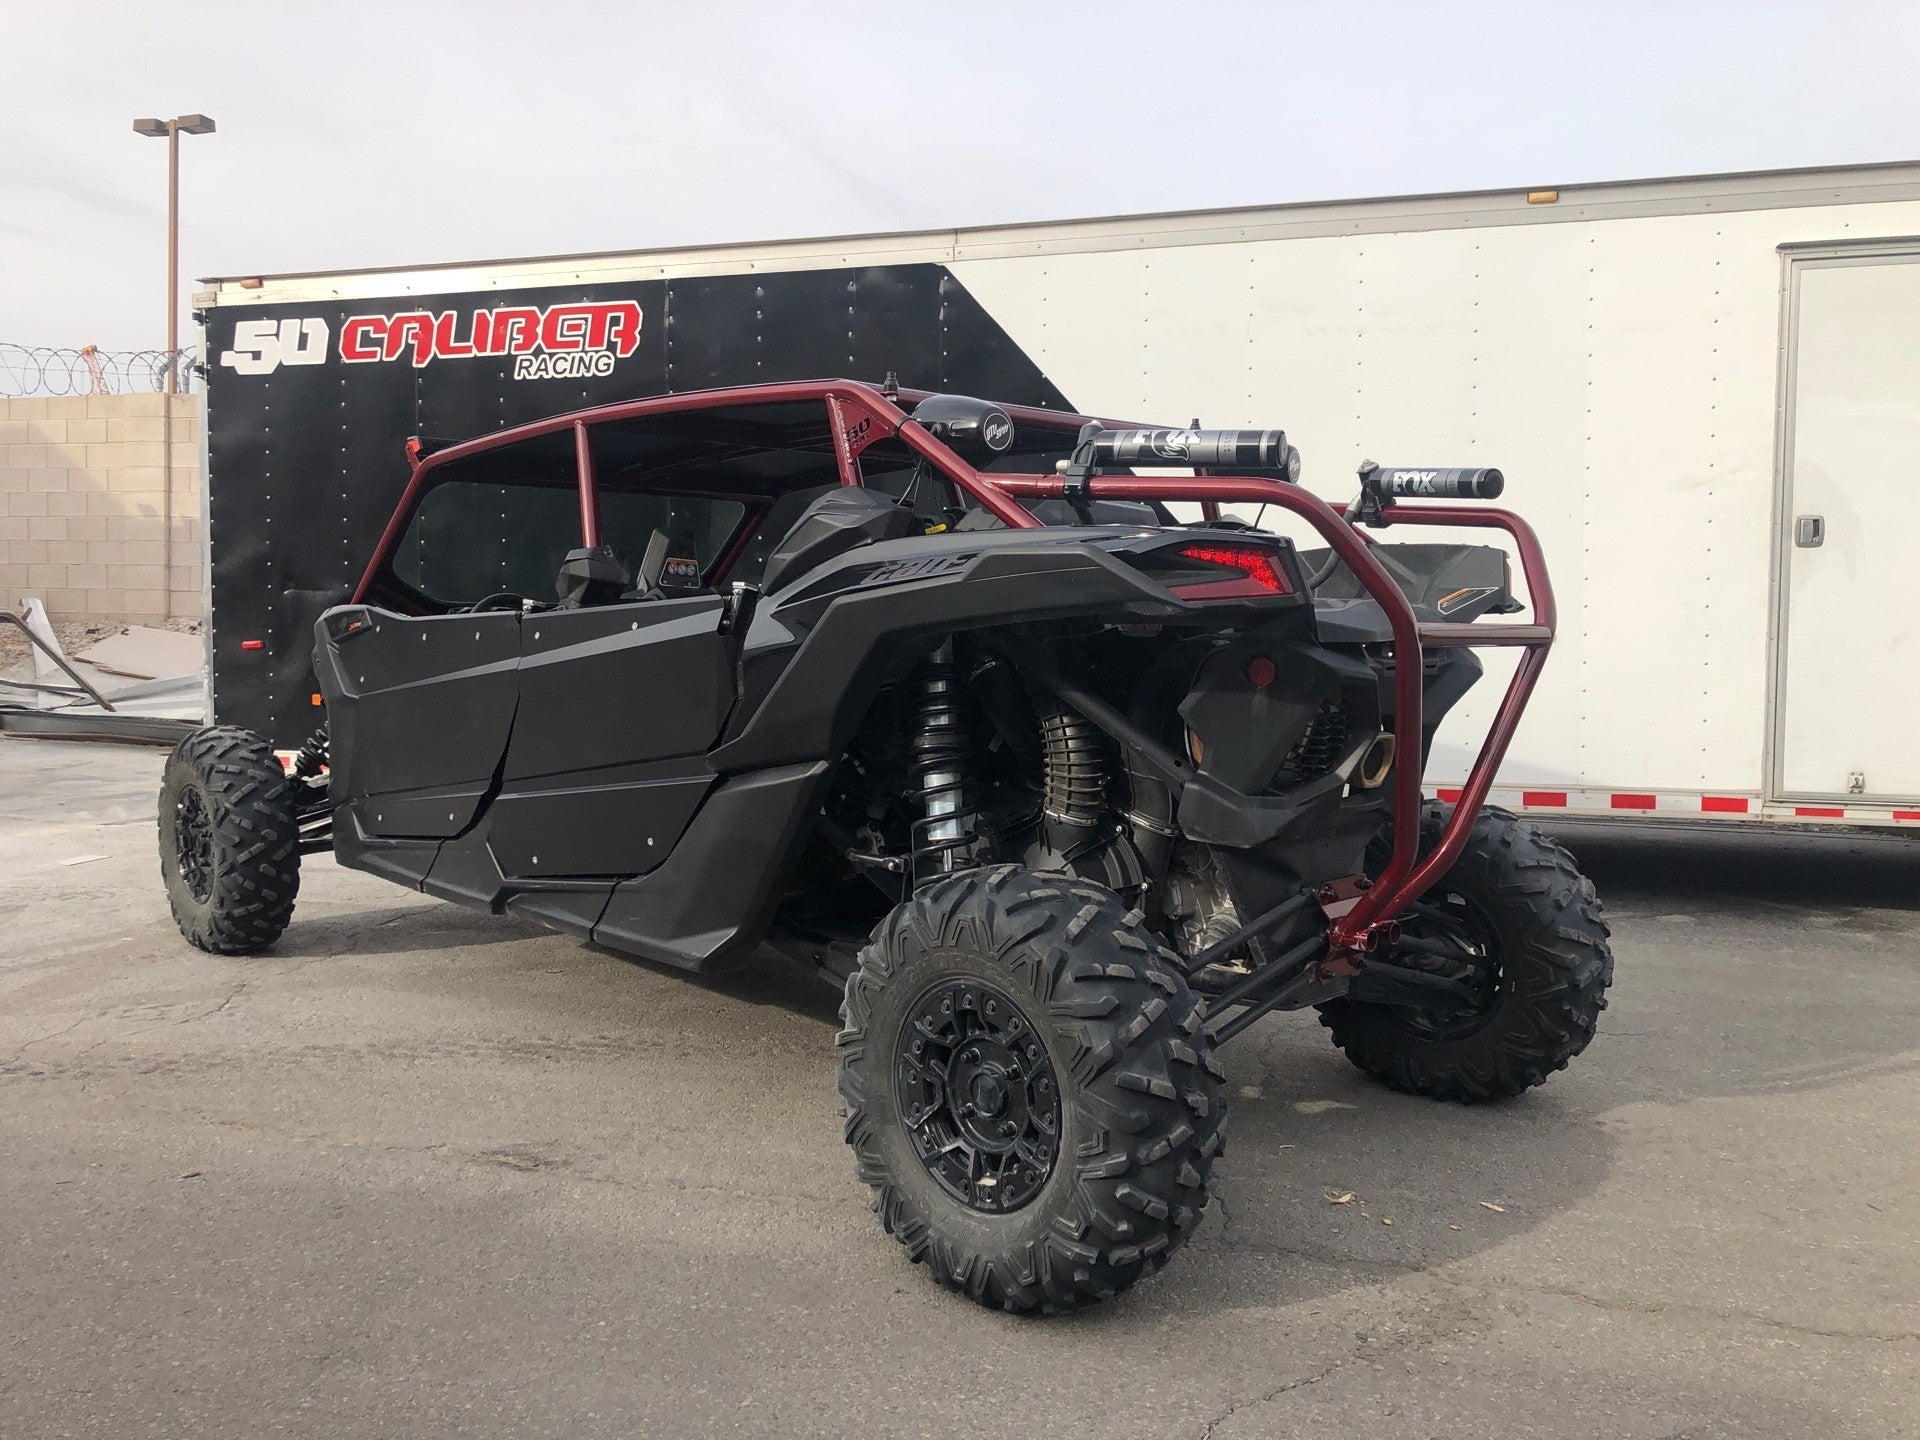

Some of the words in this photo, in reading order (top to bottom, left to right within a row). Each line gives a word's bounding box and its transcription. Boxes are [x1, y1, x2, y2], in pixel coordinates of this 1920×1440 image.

[339, 299, 644, 368] CALIBER
[514, 350, 615, 381] RACING
[845, 416, 872, 443] 50
[1392, 470, 1438, 494] FOX
